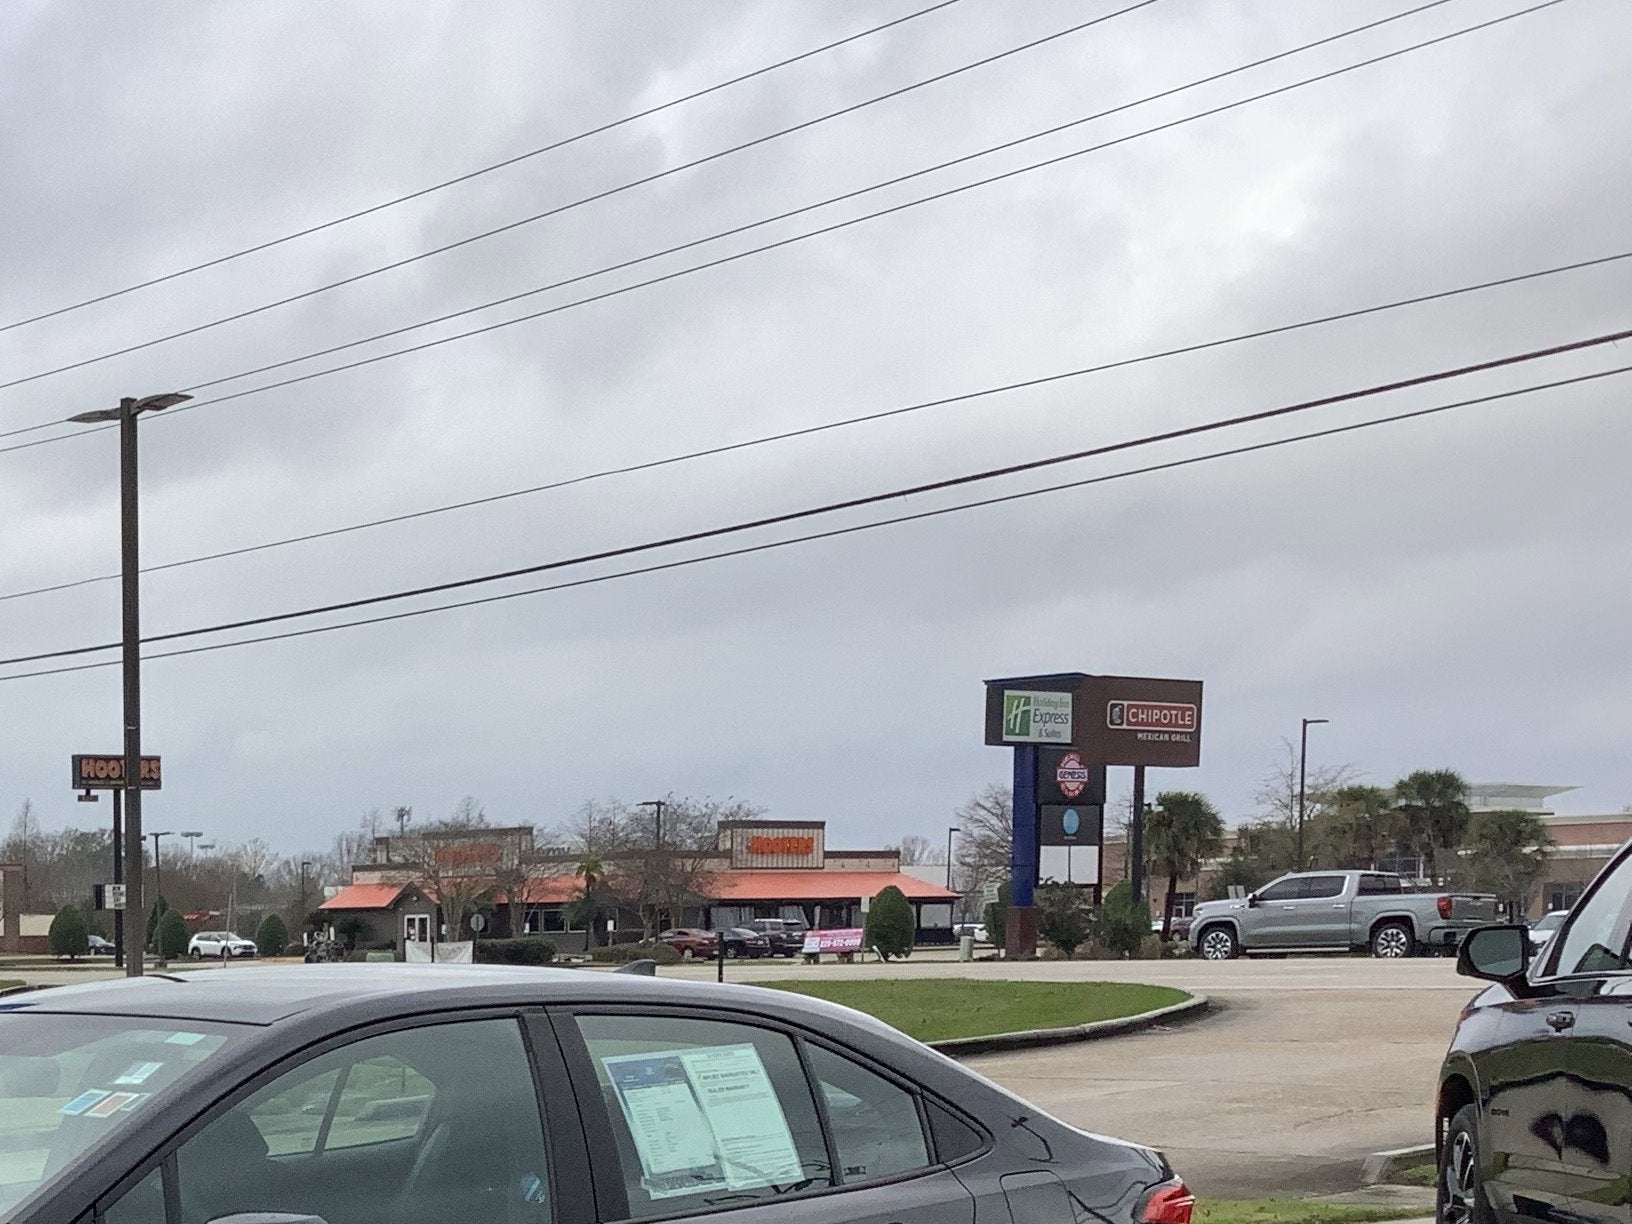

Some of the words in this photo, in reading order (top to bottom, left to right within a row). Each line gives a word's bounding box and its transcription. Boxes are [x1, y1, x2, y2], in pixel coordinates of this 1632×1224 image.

[1033, 708, 1070, 727] Express
[1128, 708, 1193, 725] CHIPOTLE
[1137, 732, 1170, 741] MEXICAN
[1171, 733, 1191, 743] GRILL
[81, 758, 160, 779] HOORS
[1058, 770, 1087, 780] GENESIS
